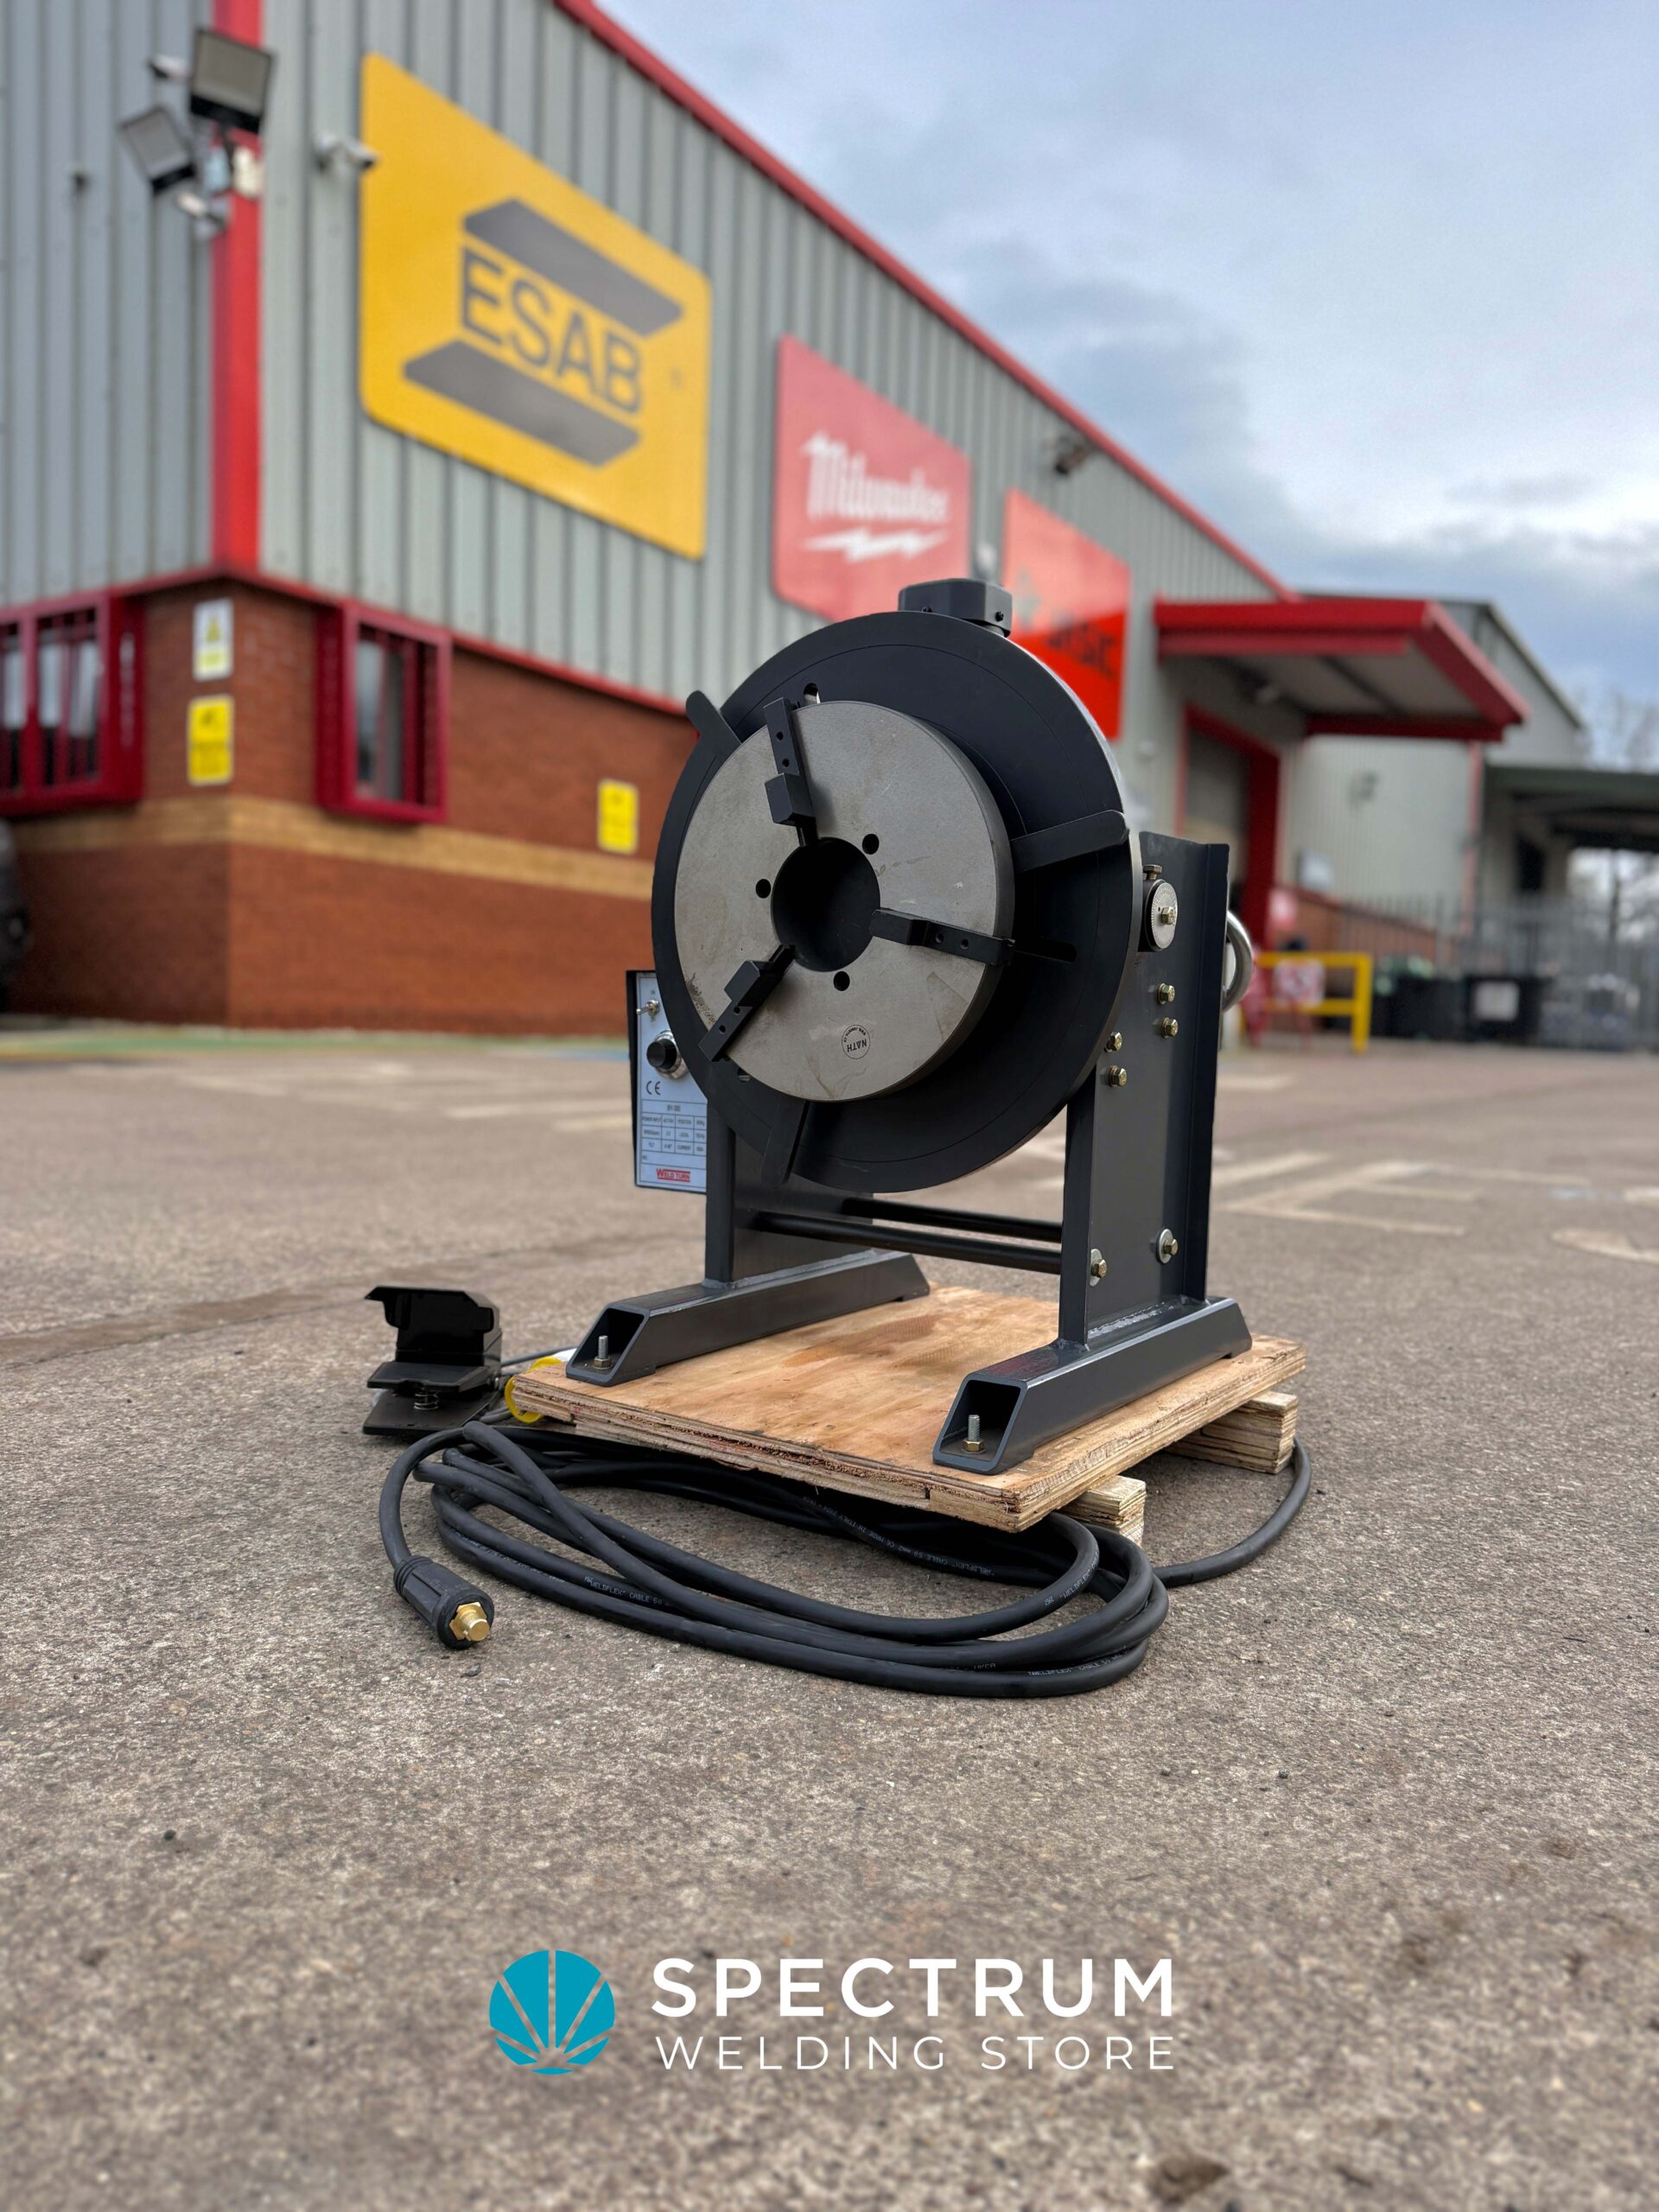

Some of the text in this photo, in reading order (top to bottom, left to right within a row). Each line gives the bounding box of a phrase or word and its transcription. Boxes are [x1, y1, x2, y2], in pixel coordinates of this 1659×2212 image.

[461, 244, 643, 416] ESAB
[847, 1039, 867, 1052] NATH
[656, 1167, 690, 1182] WELD TURN
